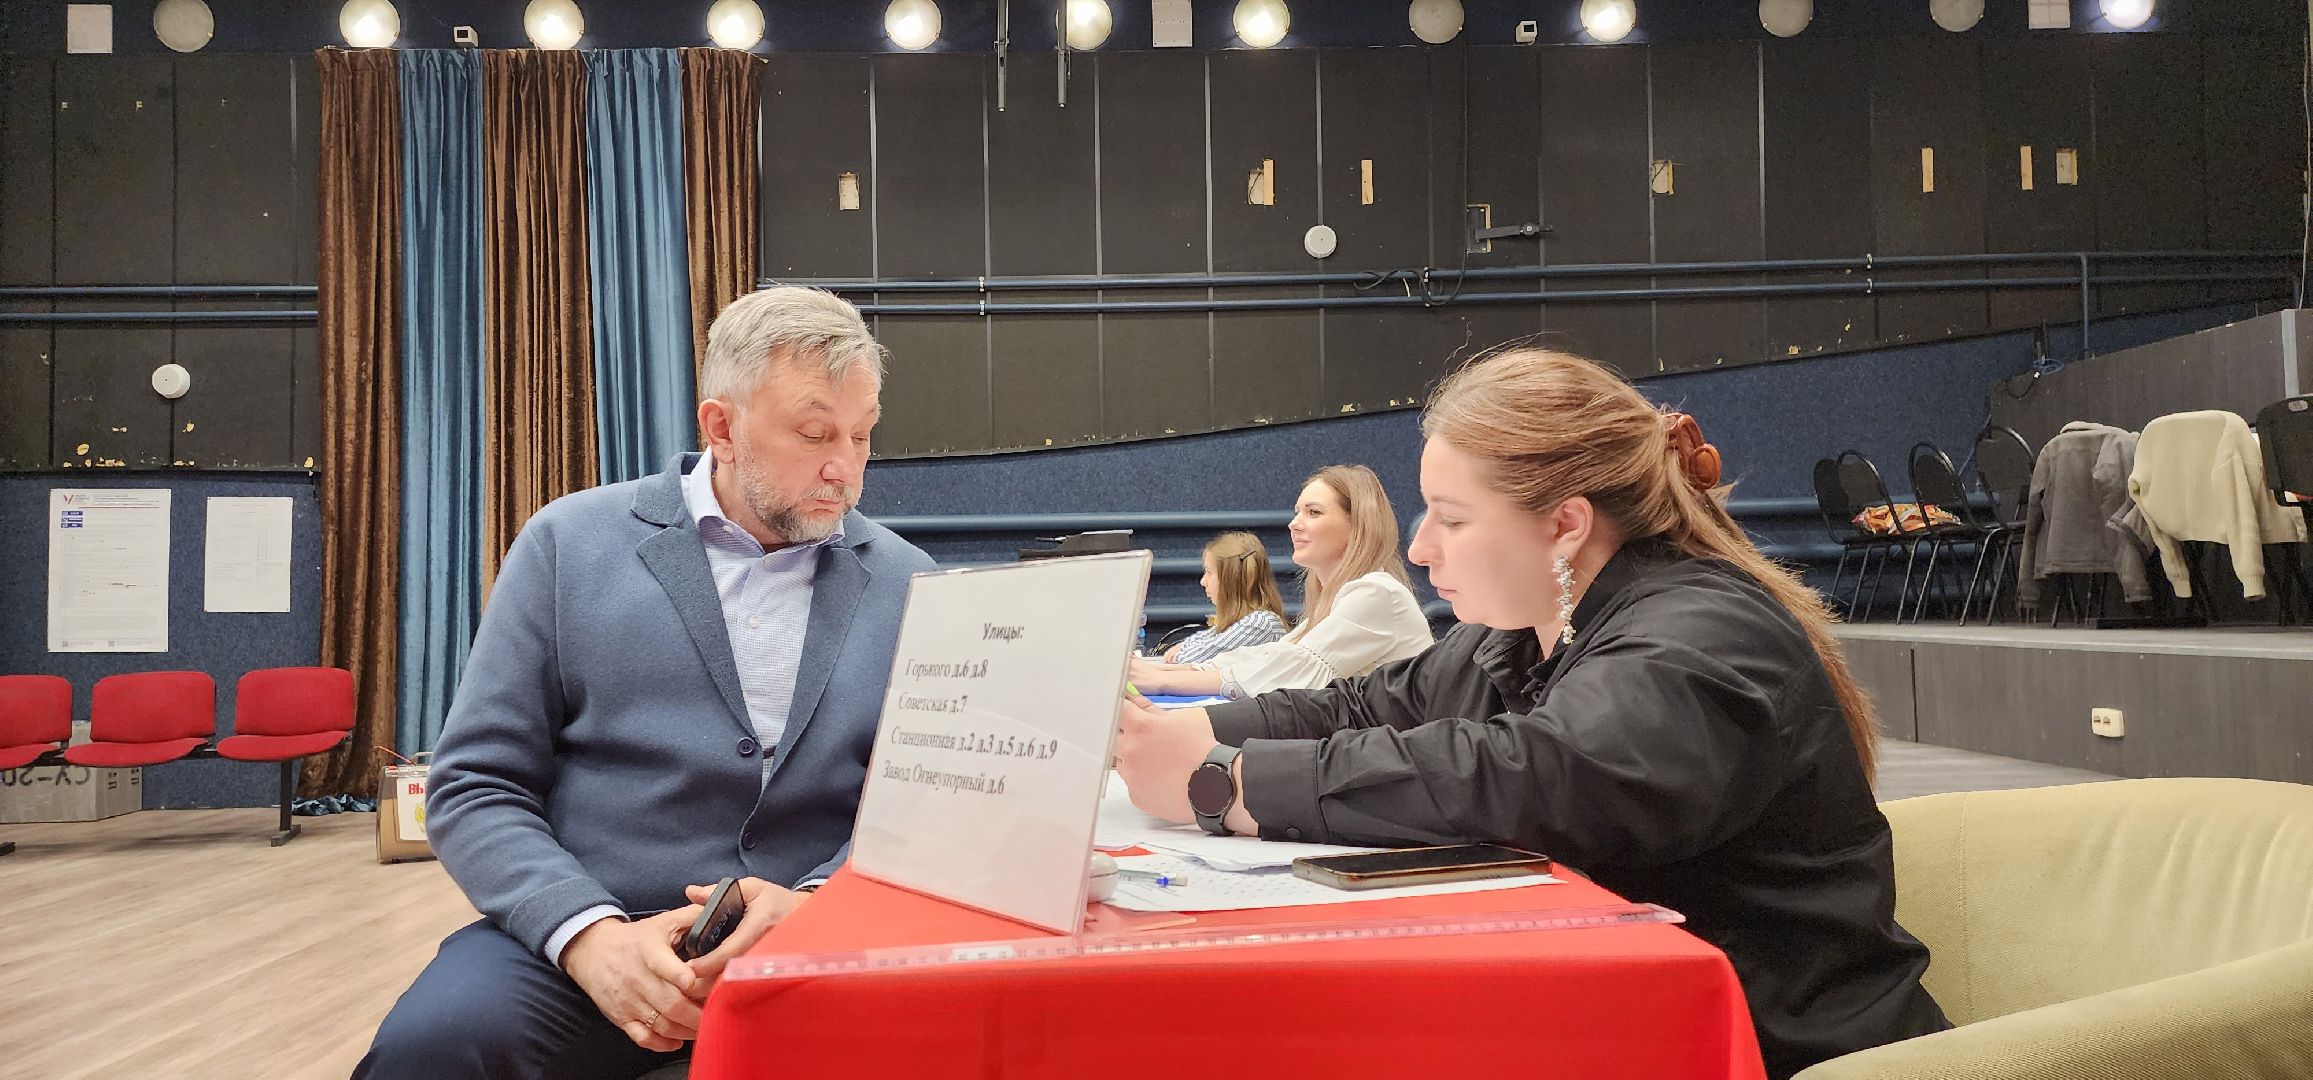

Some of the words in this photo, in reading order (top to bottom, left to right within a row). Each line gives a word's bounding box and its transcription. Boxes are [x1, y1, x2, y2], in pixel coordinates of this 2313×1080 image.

[983, 622, 1024, 643] Улицы:
[905, 658, 951, 681] Горького
[951, 659, 969, 678] д.6
[970, 658, 989, 678] д.8
[898, 692, 948, 712] Советская
[949, 695, 968, 713] д.7
[891, 726, 956, 750] Станционная
[956, 732, 975, 751] д.2
[976, 734, 995, 754] д.3
[995, 735, 1016, 755] д.5
[1015, 737, 1036, 758] д.6
[1036, 739, 1058, 760] д.9
[882, 760, 910, 782] Завод
[912, 763, 986, 794] Огнеупорный
[986, 774, 1007, 795] д.6
